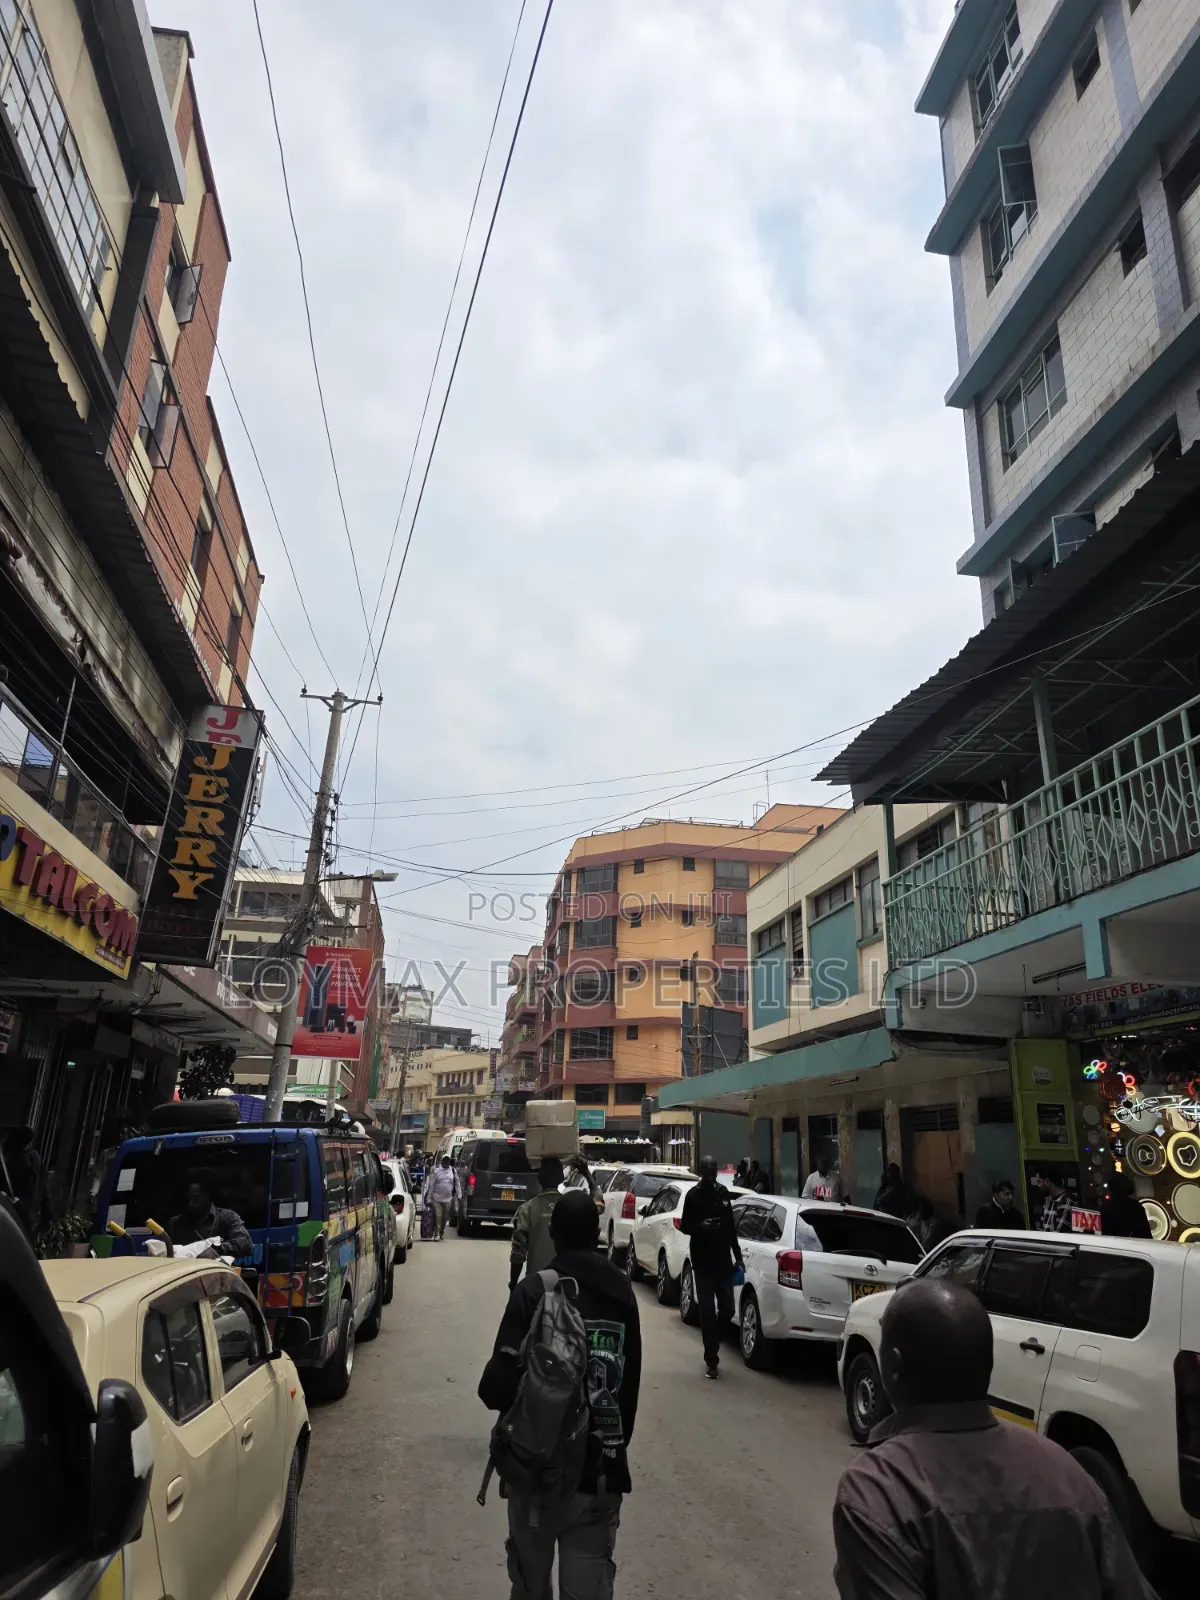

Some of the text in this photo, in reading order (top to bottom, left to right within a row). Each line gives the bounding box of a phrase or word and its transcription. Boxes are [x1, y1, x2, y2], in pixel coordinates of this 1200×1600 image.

[168, 743, 236, 901] JERRY
[1062, 982, 1165, 1008] YAS FIELDS ELE
[198, 1136, 233, 1144] STOP
[815, 1185, 832, 1197] TAXI
[1072, 1208, 1102, 1231] TAXI
